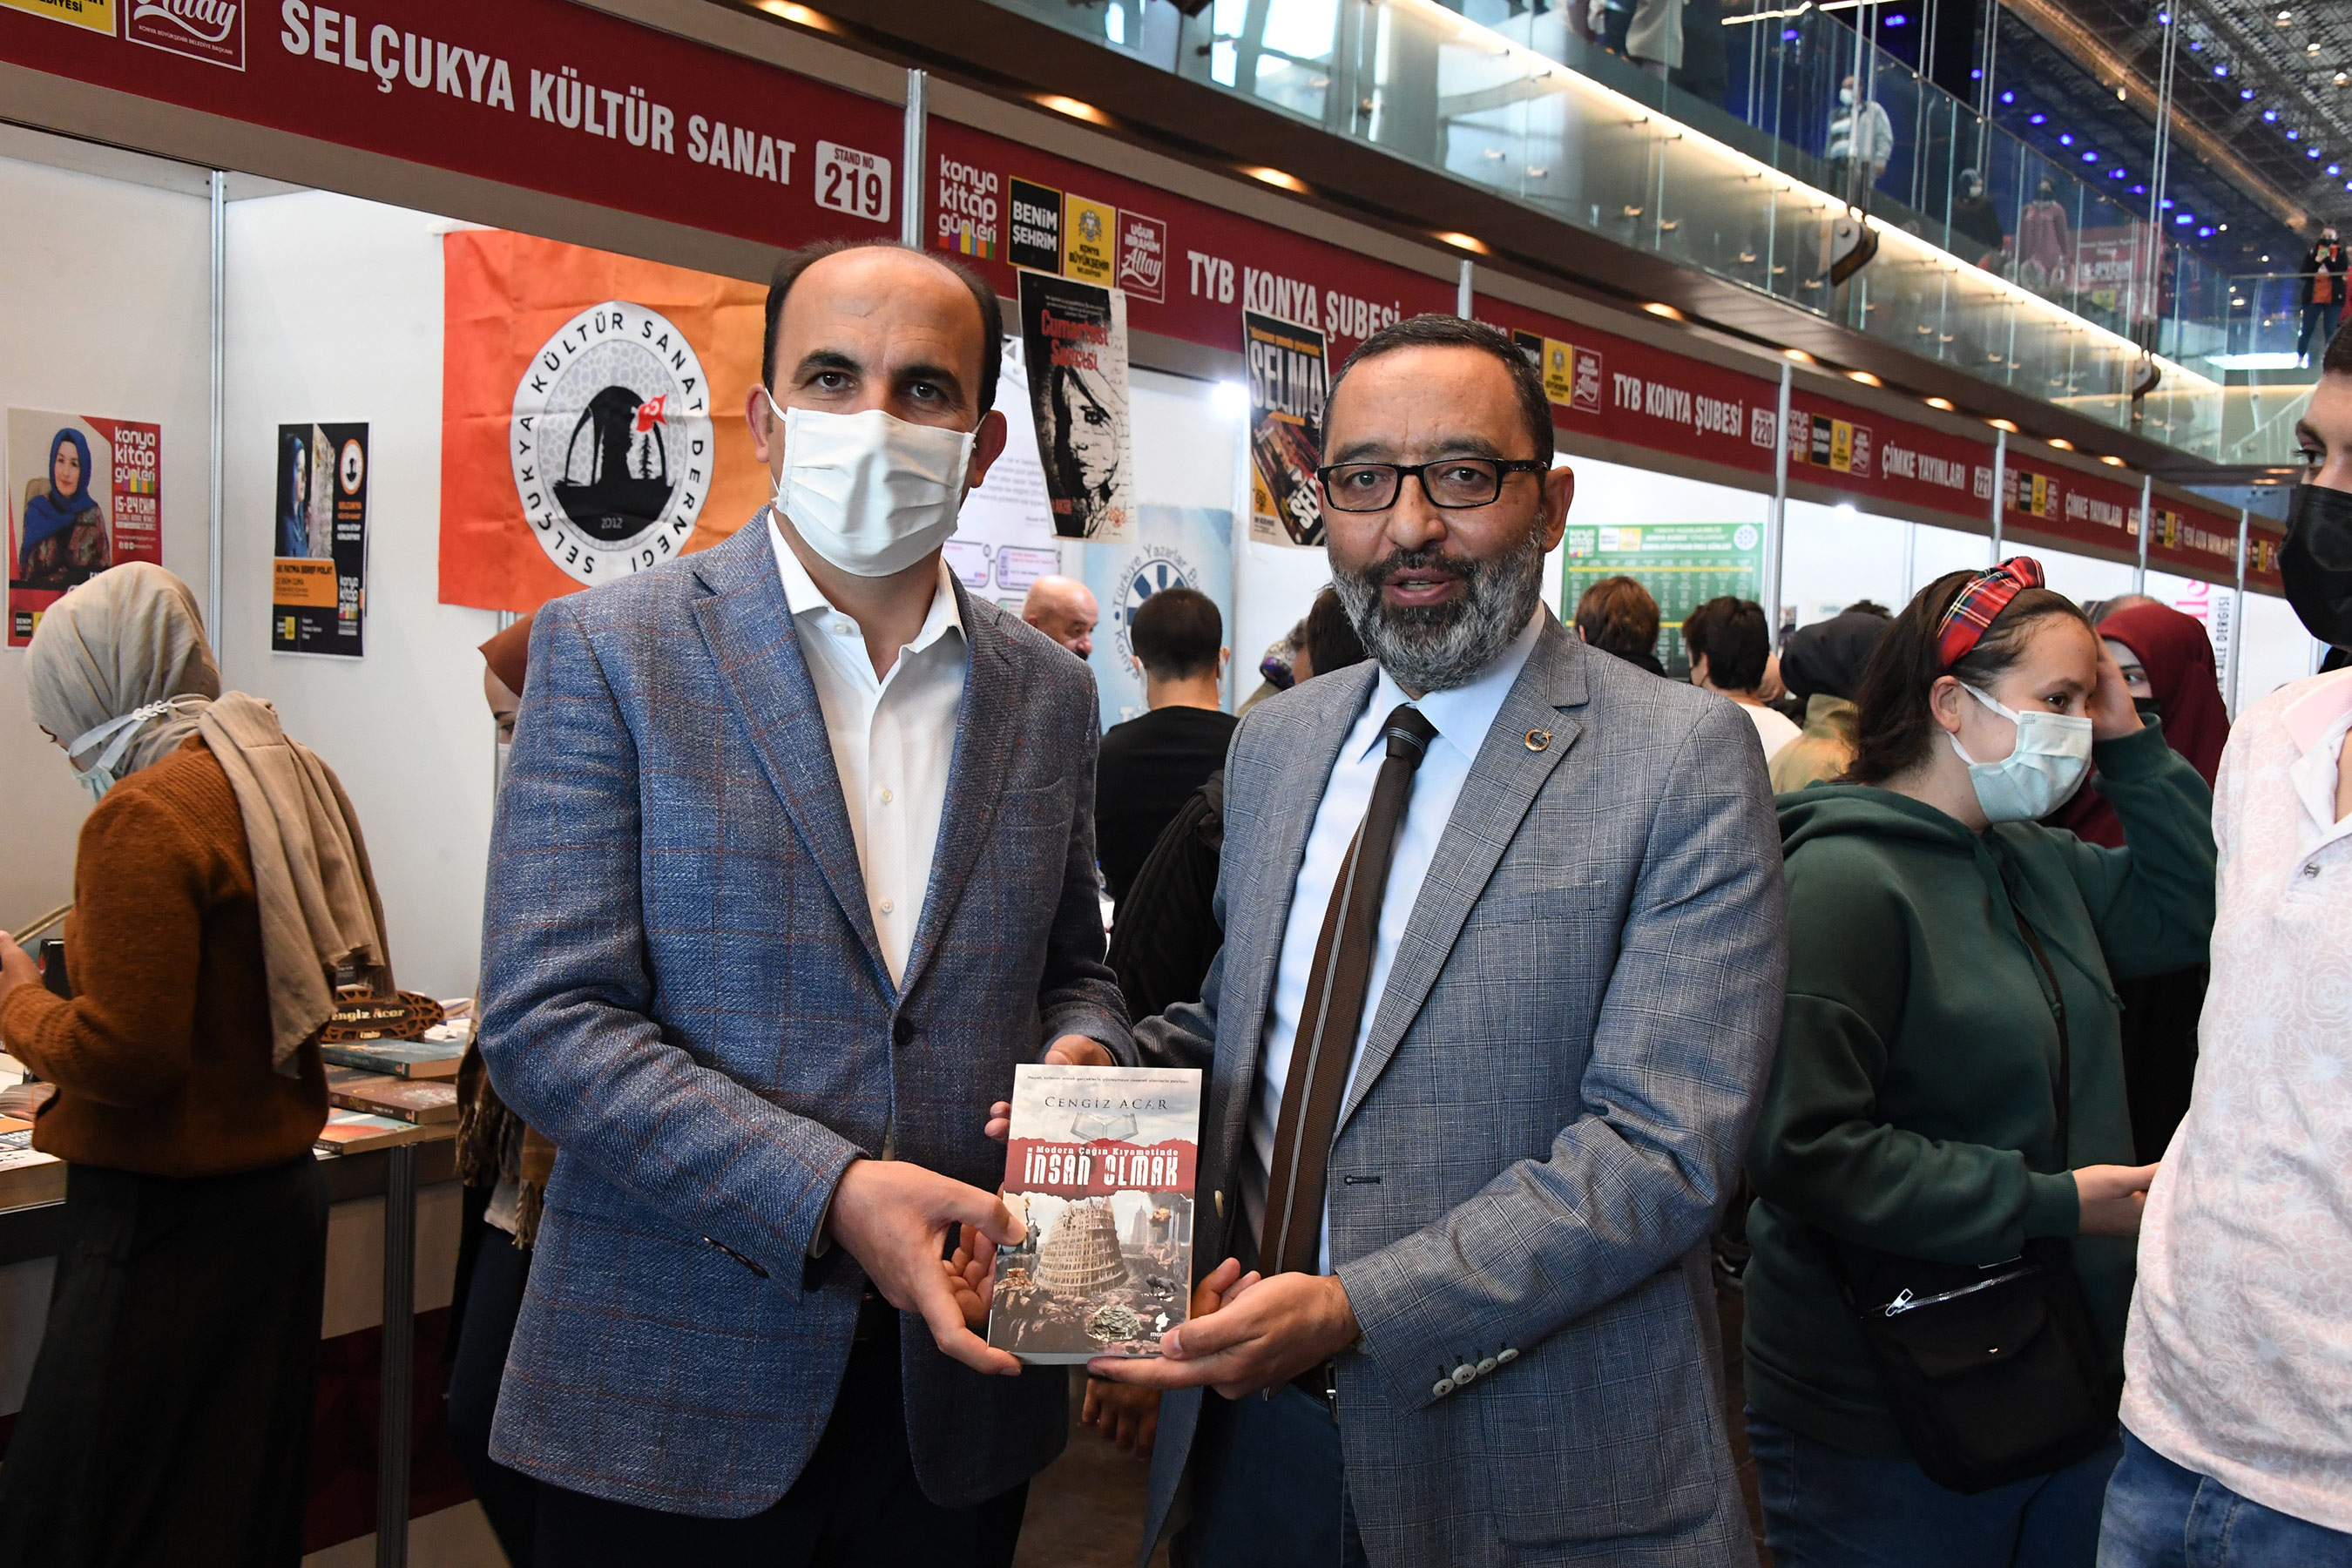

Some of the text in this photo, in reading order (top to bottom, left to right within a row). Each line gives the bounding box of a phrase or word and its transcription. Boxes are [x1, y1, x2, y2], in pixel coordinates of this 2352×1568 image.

[281, 0, 515, 113] SELÇUKYA
[530, 66, 674, 155] KÜLTÜR
[687, 115, 796, 186] SANAT
[834, 147, 875, 170] STAND NO
[940, 153, 998, 196] konya
[824, 161, 882, 217] 219
[939, 179, 997, 225] kitap
[938, 213, 997, 244] günleri
[1012, 199, 1058, 232] BENİM
[1012, 224, 1058, 253] ŞEHRİM
[1187, 250, 1235, 304] TYB
[1243, 265, 1318, 327] KONYA
[1325, 291, 1401, 343] ŞUBESİ
[531, 311, 625, 395] KÜLTÜR
[641, 320, 704, 413] SANAT
[1249, 339, 1323, 418] SELMA
[1613, 372, 1642, 413] TYB
[1646, 381, 1693, 426] KONYA
[1695, 398, 1743, 437] ŞUBESİ
[114, 426, 156, 450] konya
[1754, 418, 1774, 447] 220
[114, 443, 156, 470] kitap
[1882, 439, 1916, 481] ÇİMKE
[114, 465, 156, 483] günleri
[519, 415, 596, 574] SELÇUKYA
[331, 1009, 372, 1023] engiz
[1044, 1096, 1169, 1111] CENGİZ ACAR
[1036, 1146, 1179, 1157] Modern Çağın Kıyametinde
[1104, 1154, 1179, 1186] OLMAK
